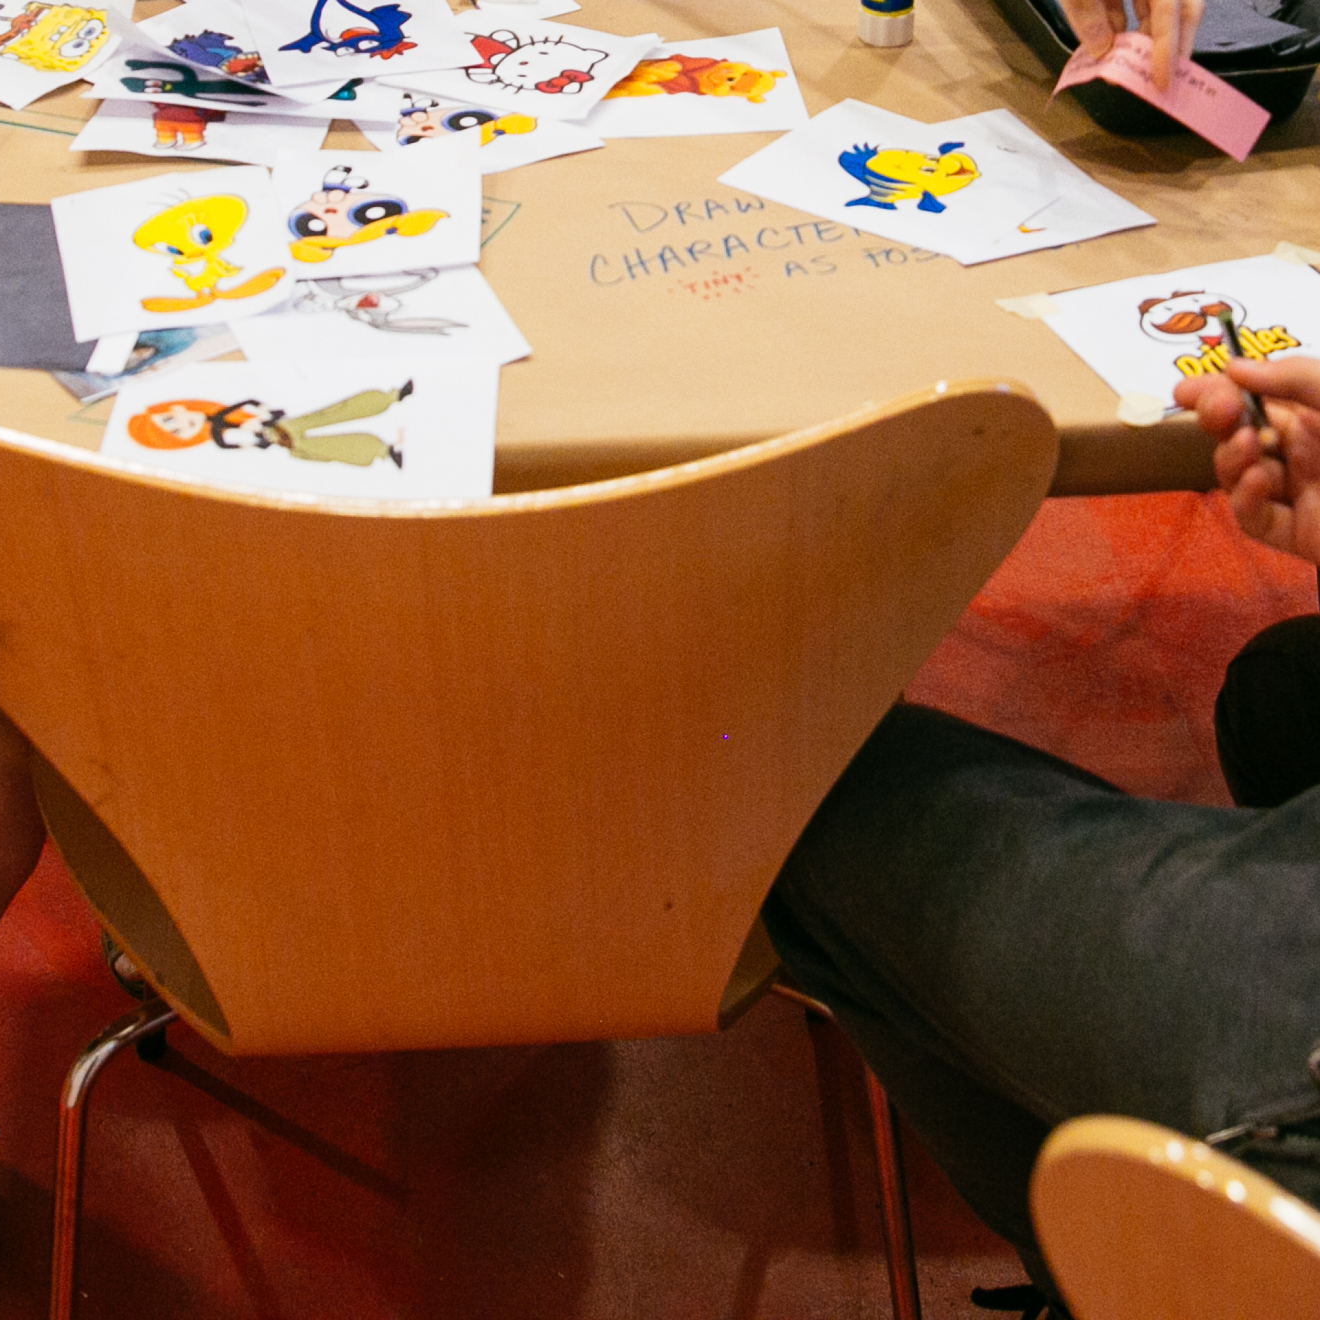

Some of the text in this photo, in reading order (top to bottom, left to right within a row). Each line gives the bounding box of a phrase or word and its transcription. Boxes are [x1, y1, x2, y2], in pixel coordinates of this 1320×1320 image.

[608, 194, 765, 233] DRAW
[589, 218, 861, 288] CHARACTE
[683, 272, 744, 295] TINY
[784, 254, 838, 278] AS
